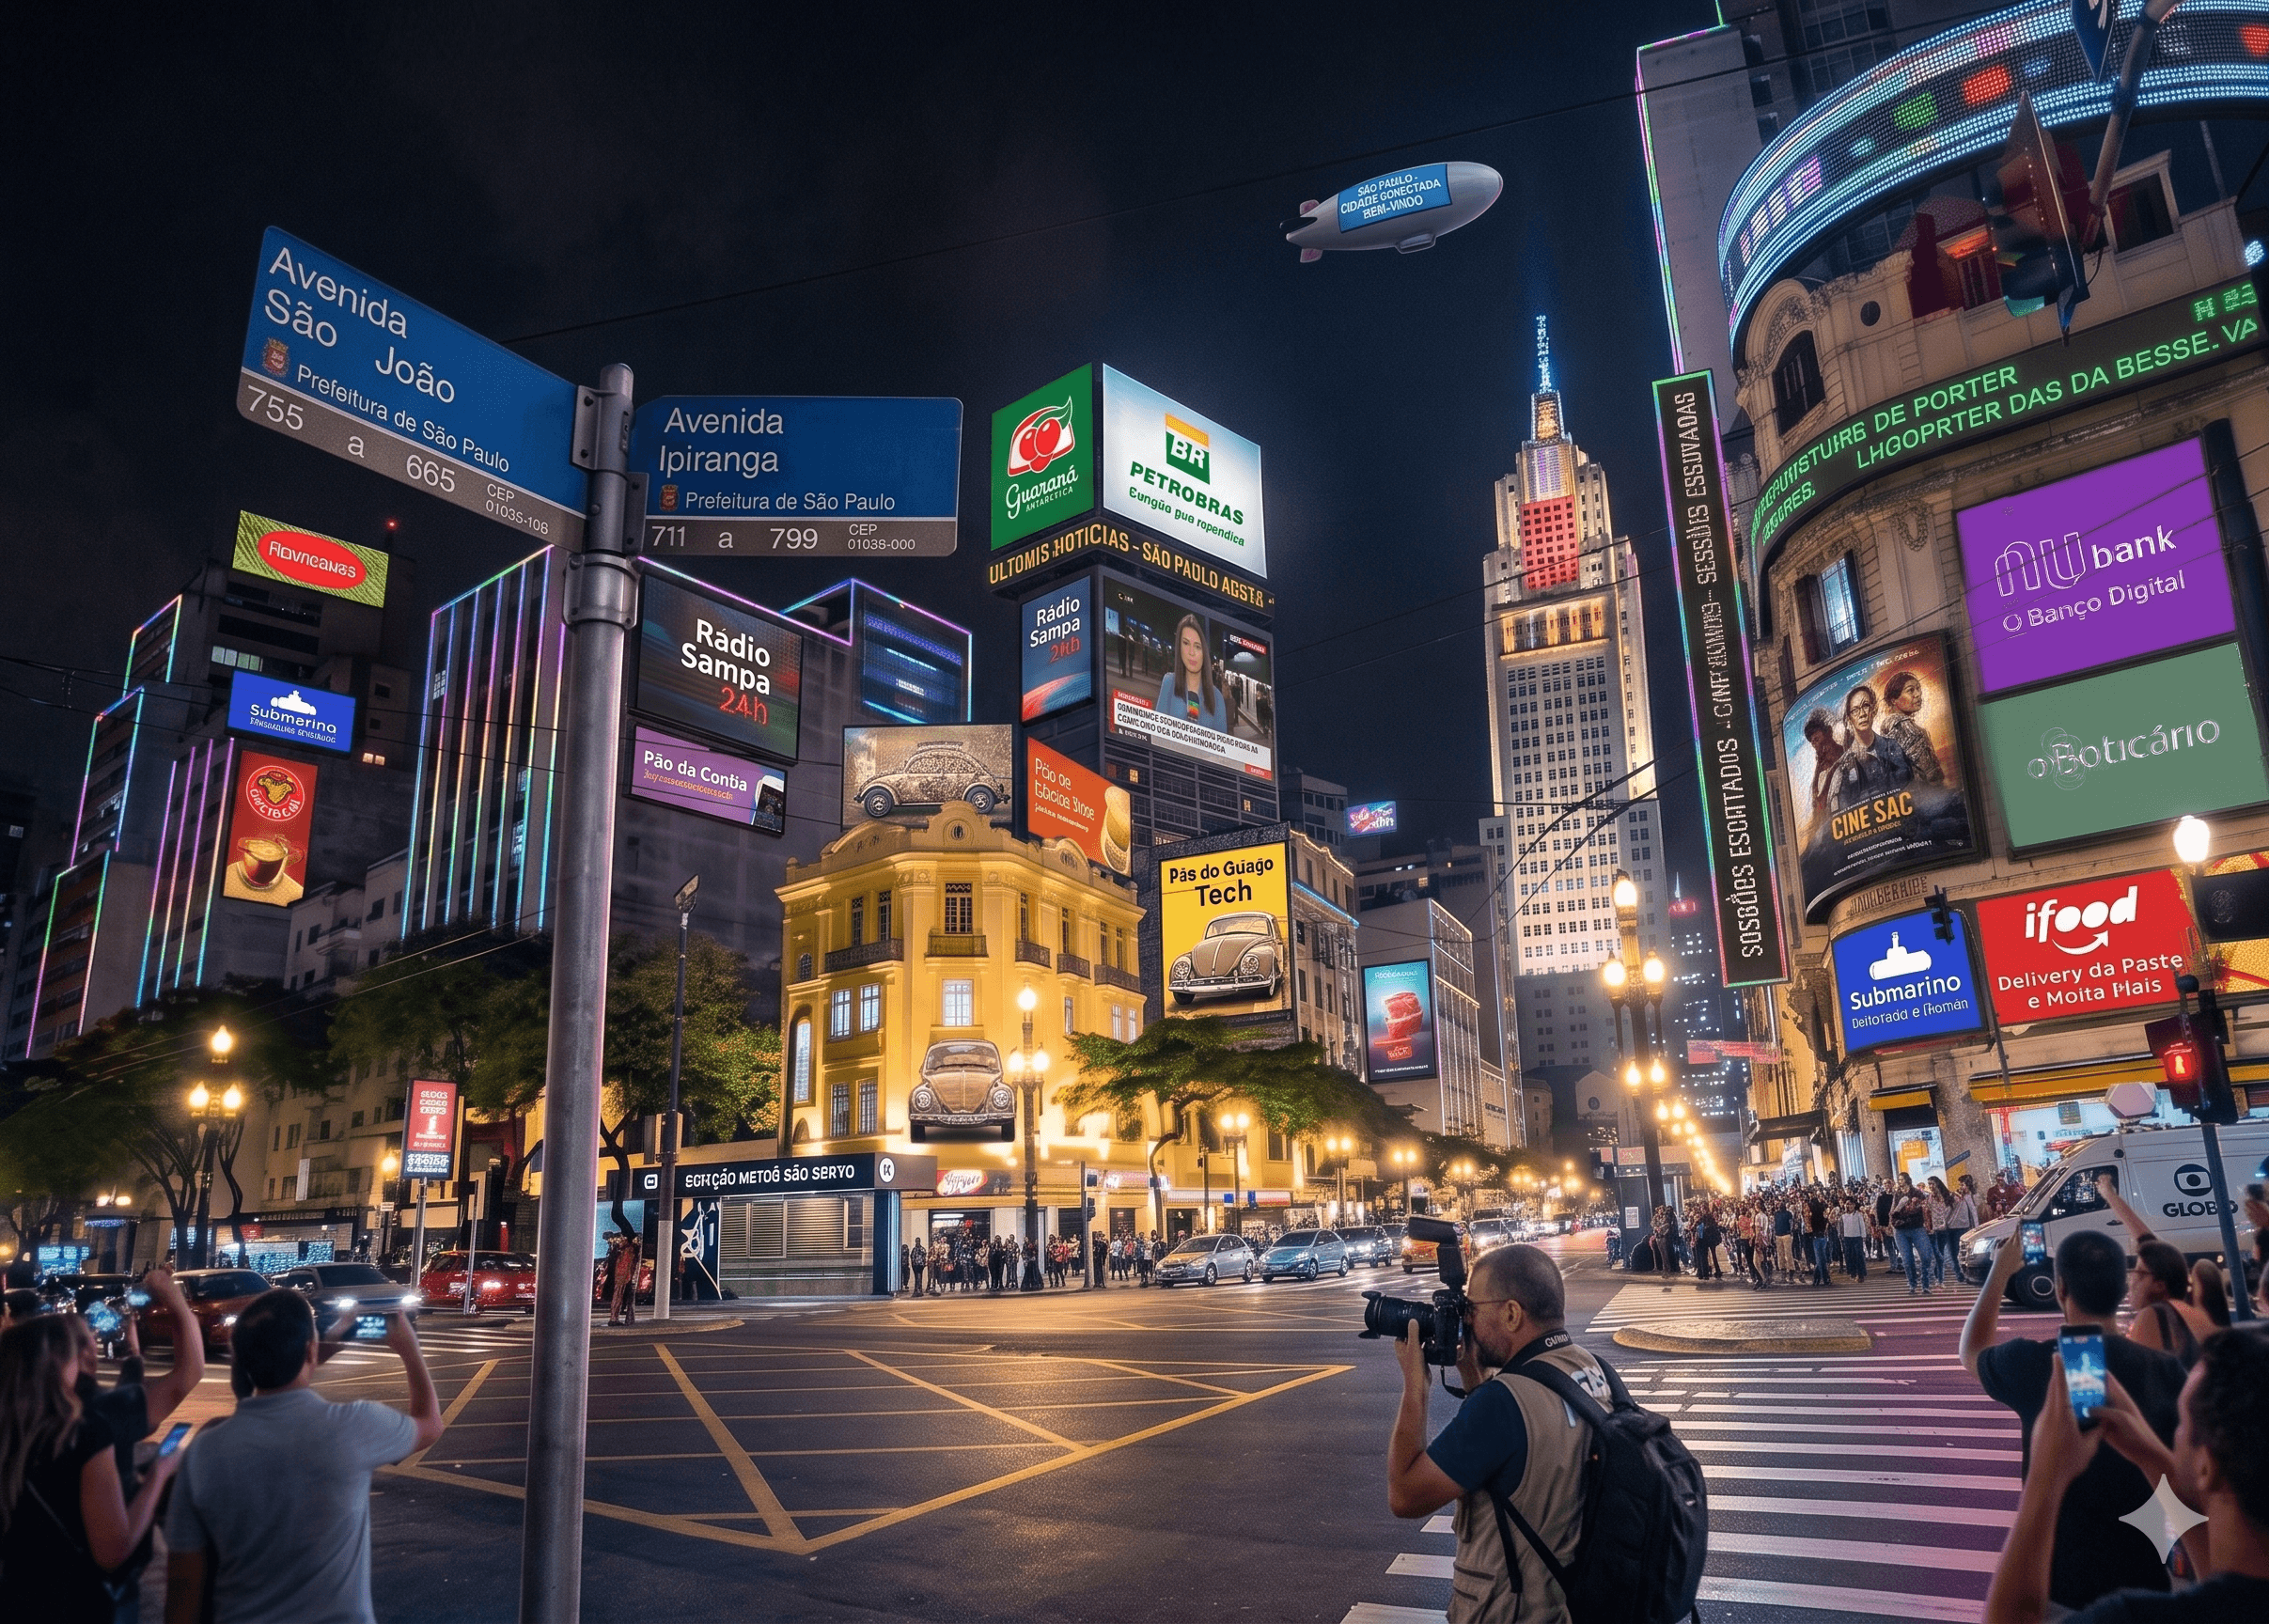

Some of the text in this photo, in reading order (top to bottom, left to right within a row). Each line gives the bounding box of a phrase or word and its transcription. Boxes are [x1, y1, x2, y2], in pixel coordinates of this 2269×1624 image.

[268, 246, 407, 338] Avenida
[264, 289, 455, 403] São João
[2009, 380, 2063, 415] DAS
[2071, 366, 2110, 395] DA
[2116, 331, 2219, 380] BESSE.
[1874, 403, 1906, 433] DE
[1913, 366, 2018, 418] PORTER
[296, 364, 509, 473] Prefeitura de São Paulo
[664, 407, 784, 434] Avenida
[247, 384, 456, 492] 755 a 665
[1170, 437, 1206, 470] BR
[659, 445, 779, 479] Ipiranga
[486, 483, 515, 503] CEP
[685, 492, 896, 510] Prefeitura de São Paulo
[1005, 463, 1079, 520] Guaraná
[1129, 461, 1244, 525] PETROBRAS
[651, 525, 819, 550] 711 a 799
[849, 523, 878, 536] CEP
[1174, 555, 1218, 588] PAULO
[1036, 596, 1081, 628] Rádio
[2002, 614, 2023, 633] O
[2108, 569, 2186, 609] Digital
[696, 617, 771, 667] Rádio
[1029, 617, 1081, 648] Sampa
[681, 642, 771, 695] Sampa
[719, 685, 769, 726] 24h
[644, 749, 673, 772] Pão
[678, 759, 696, 778] da
[1831, 804, 1871, 840] CINE
[1873, 791, 1914, 823] SAC
[1199, 863, 1220, 881] do
[1195, 878, 1252, 907] Tech
[1997, 953, 2183, 992] Delivery da Paste
[1850, 976, 1962, 1011] Submarino
[2027, 995, 2041, 1009] e
[2046, 986, 2105, 1007] Moita
[1912, 1007, 1920, 1017] e
